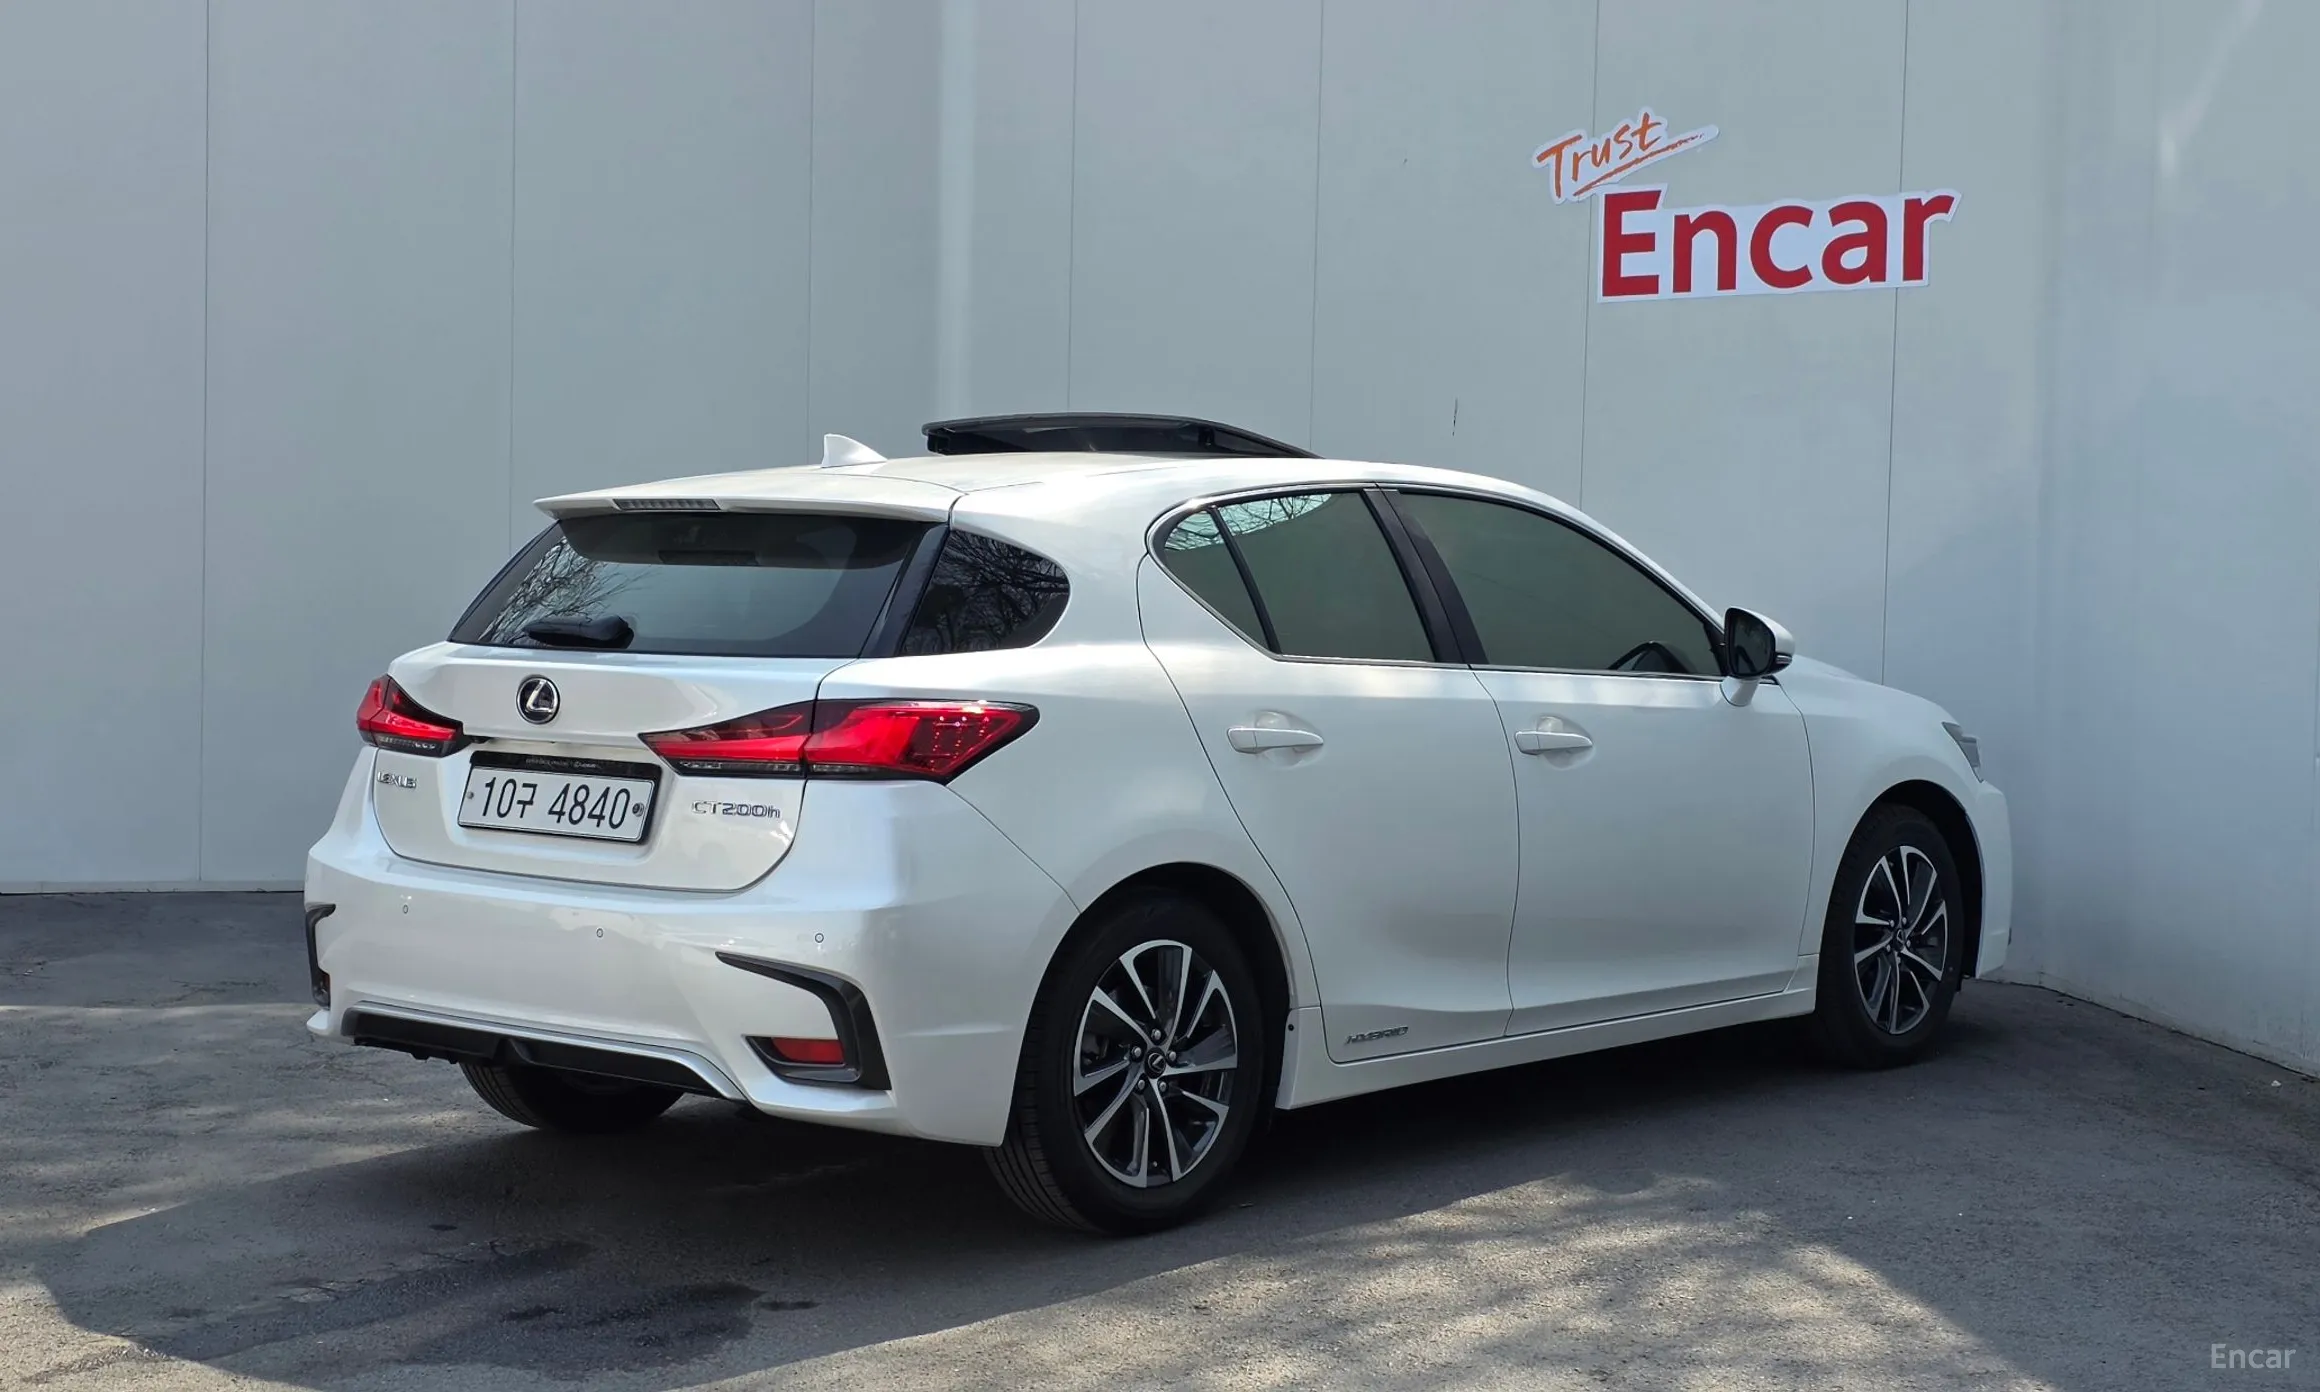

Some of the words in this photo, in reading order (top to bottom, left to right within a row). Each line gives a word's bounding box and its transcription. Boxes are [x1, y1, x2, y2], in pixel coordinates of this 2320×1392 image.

[1537, 112, 1662, 198] Trust
[1602, 189, 1955, 297] Encar
[482, 776, 538, 818] 10구
[548, 783, 631, 830] 4840
